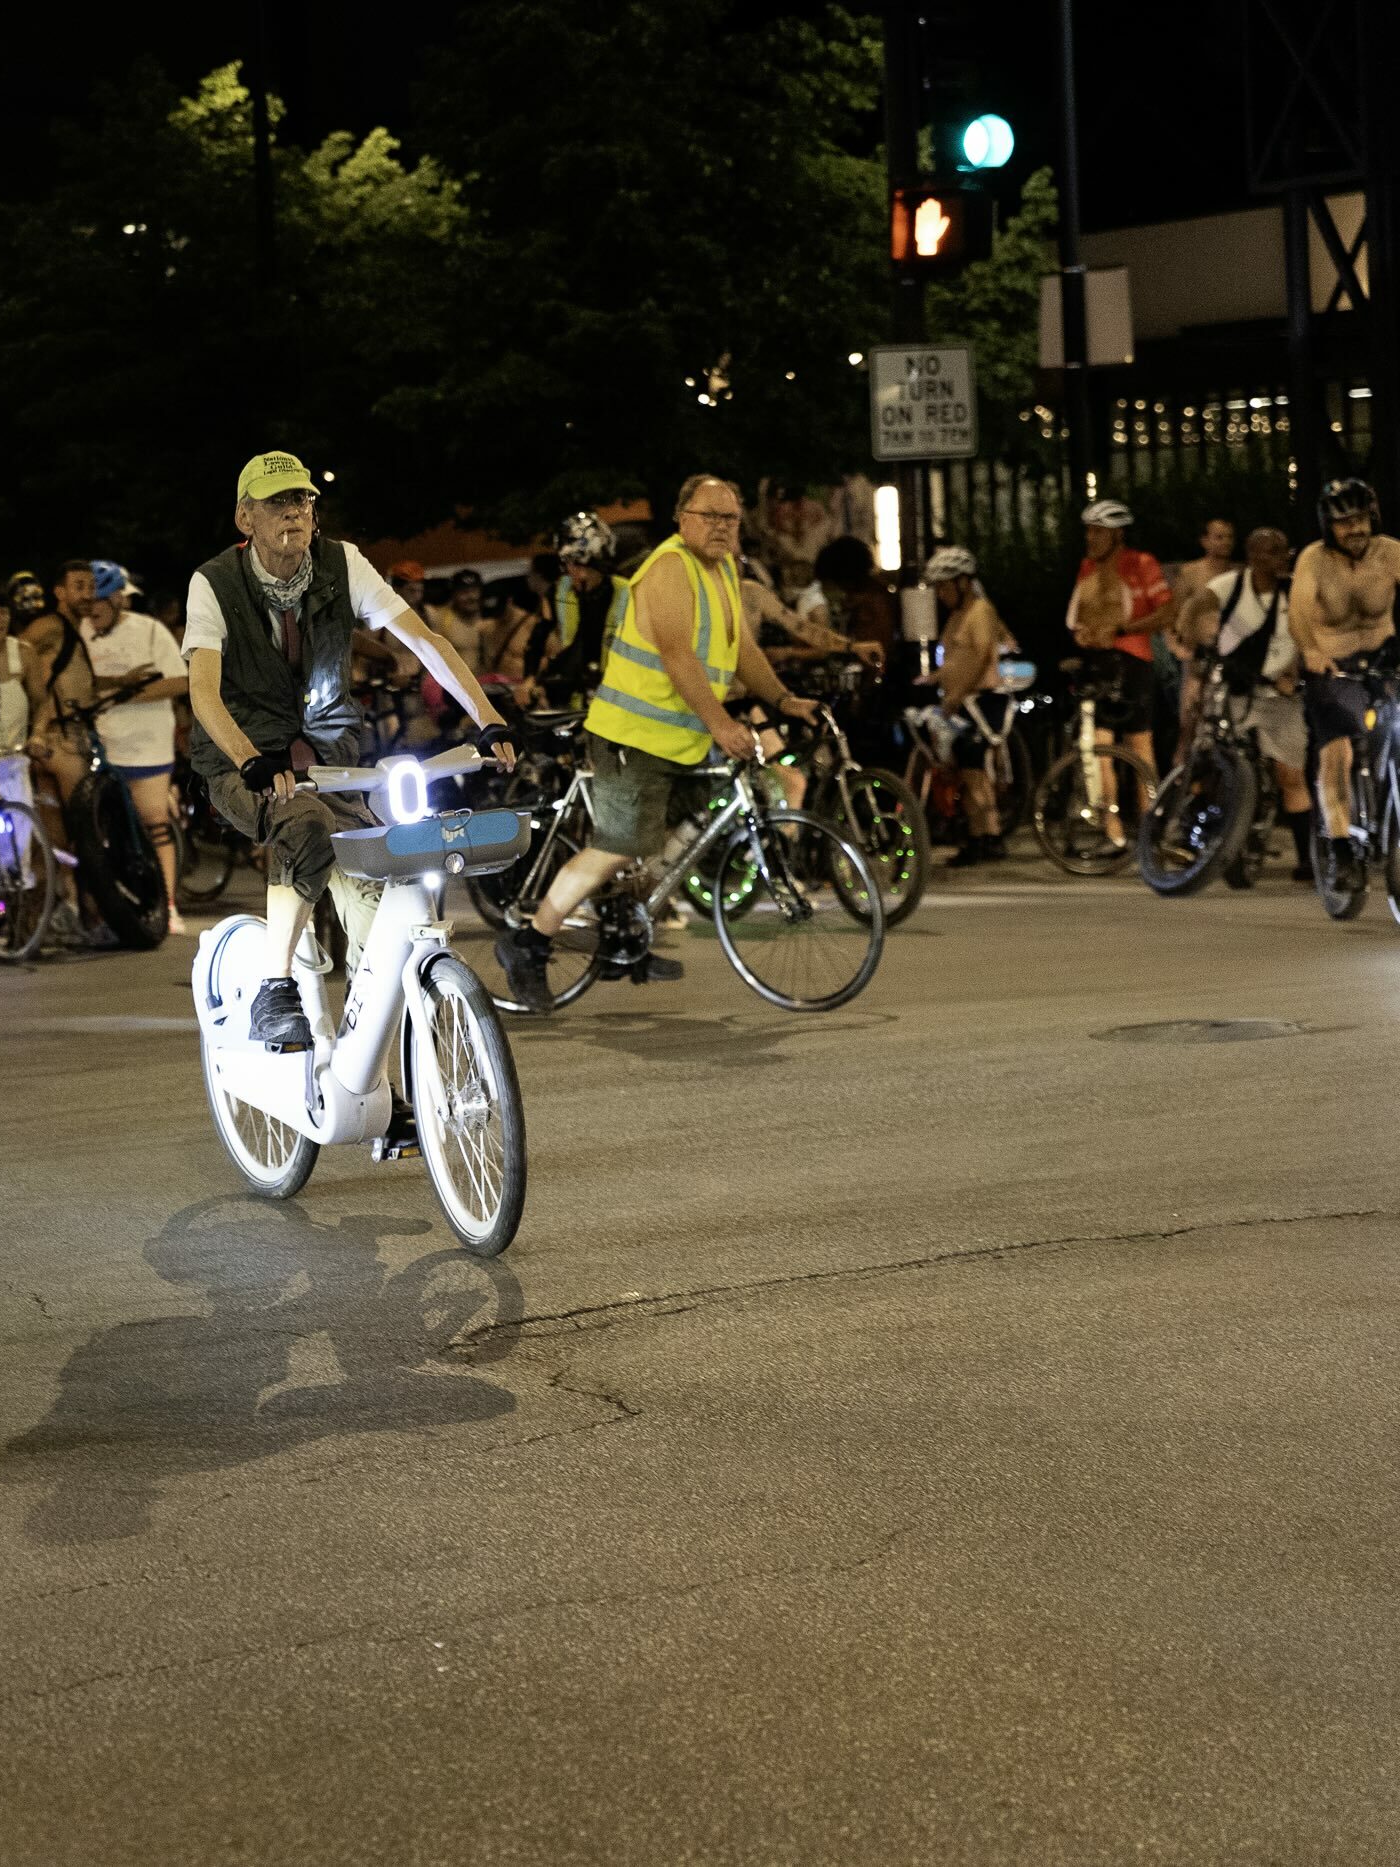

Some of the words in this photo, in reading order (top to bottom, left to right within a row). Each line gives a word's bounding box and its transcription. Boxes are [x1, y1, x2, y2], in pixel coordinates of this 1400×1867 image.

[906, 355, 940, 376] NO
[895, 379, 955, 402] TURN
[882, 405, 913, 427] ON
[925, 402, 967, 425] RED
[346, 958, 374, 1031] DIY
